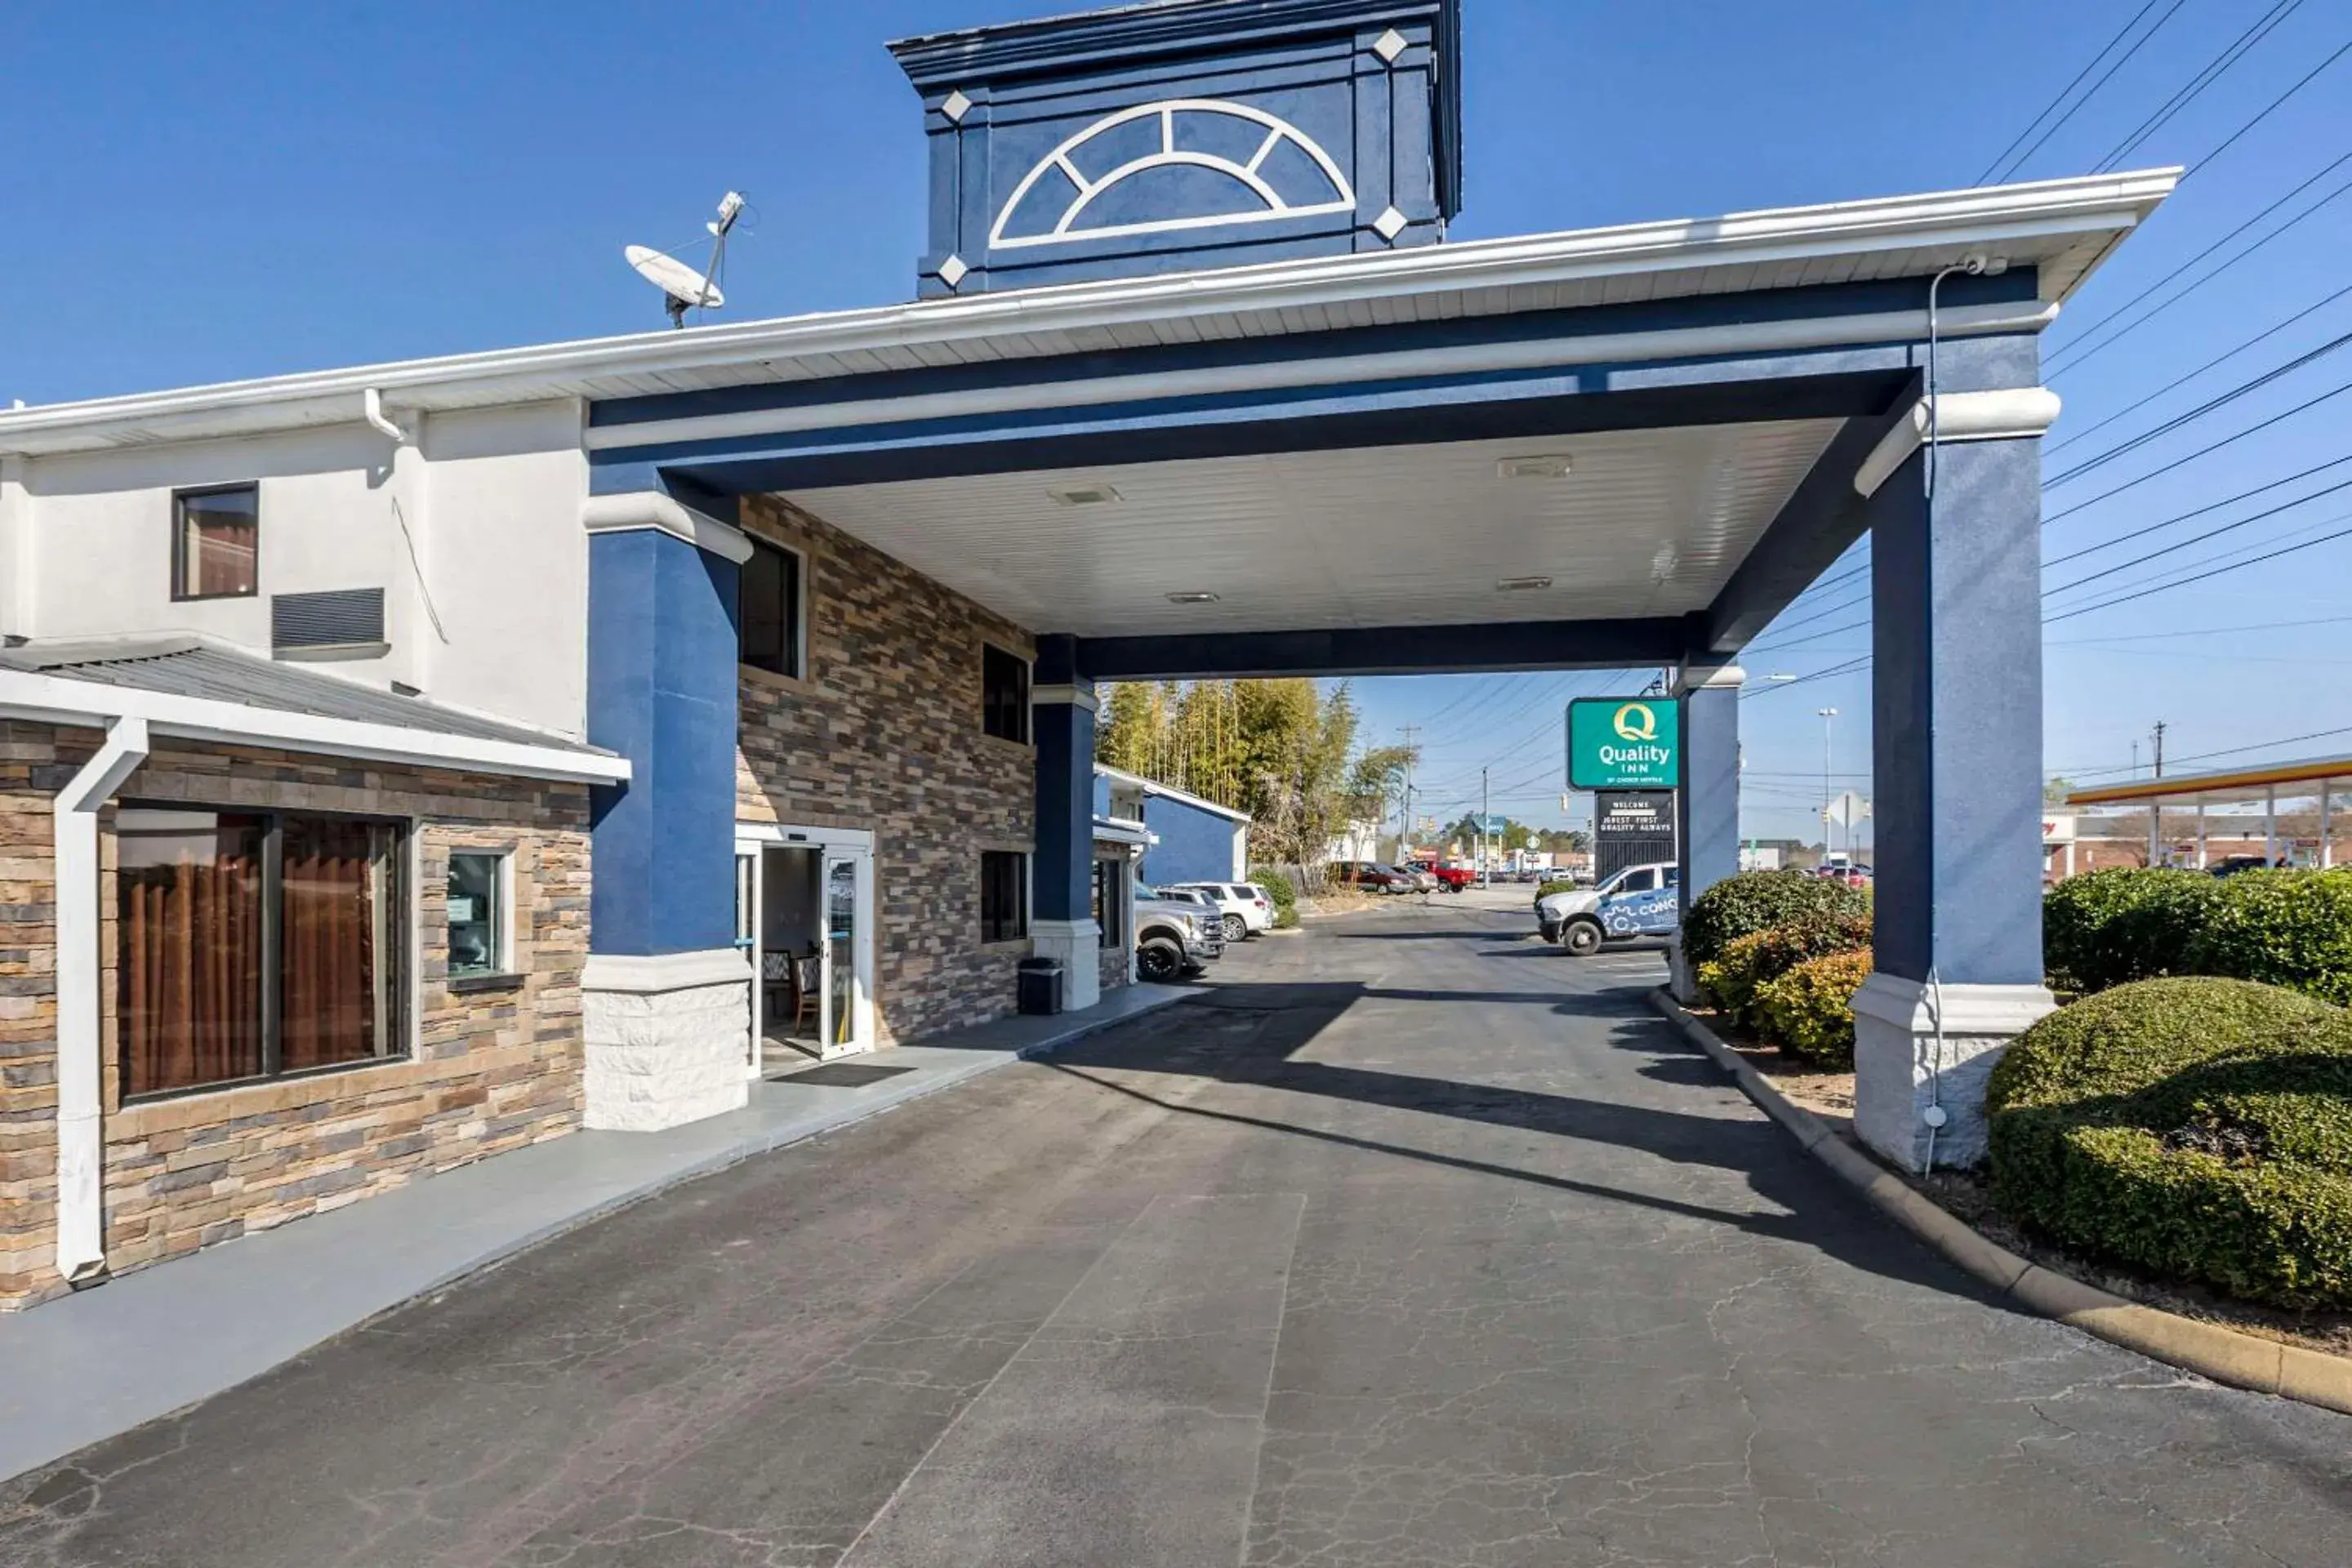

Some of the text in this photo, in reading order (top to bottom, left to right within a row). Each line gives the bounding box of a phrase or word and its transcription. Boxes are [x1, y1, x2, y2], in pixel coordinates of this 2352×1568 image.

[1614, 702, 1659, 742] Q
[1599, 745, 1670, 764] Quality
[1621, 763, 1649, 773] INN
